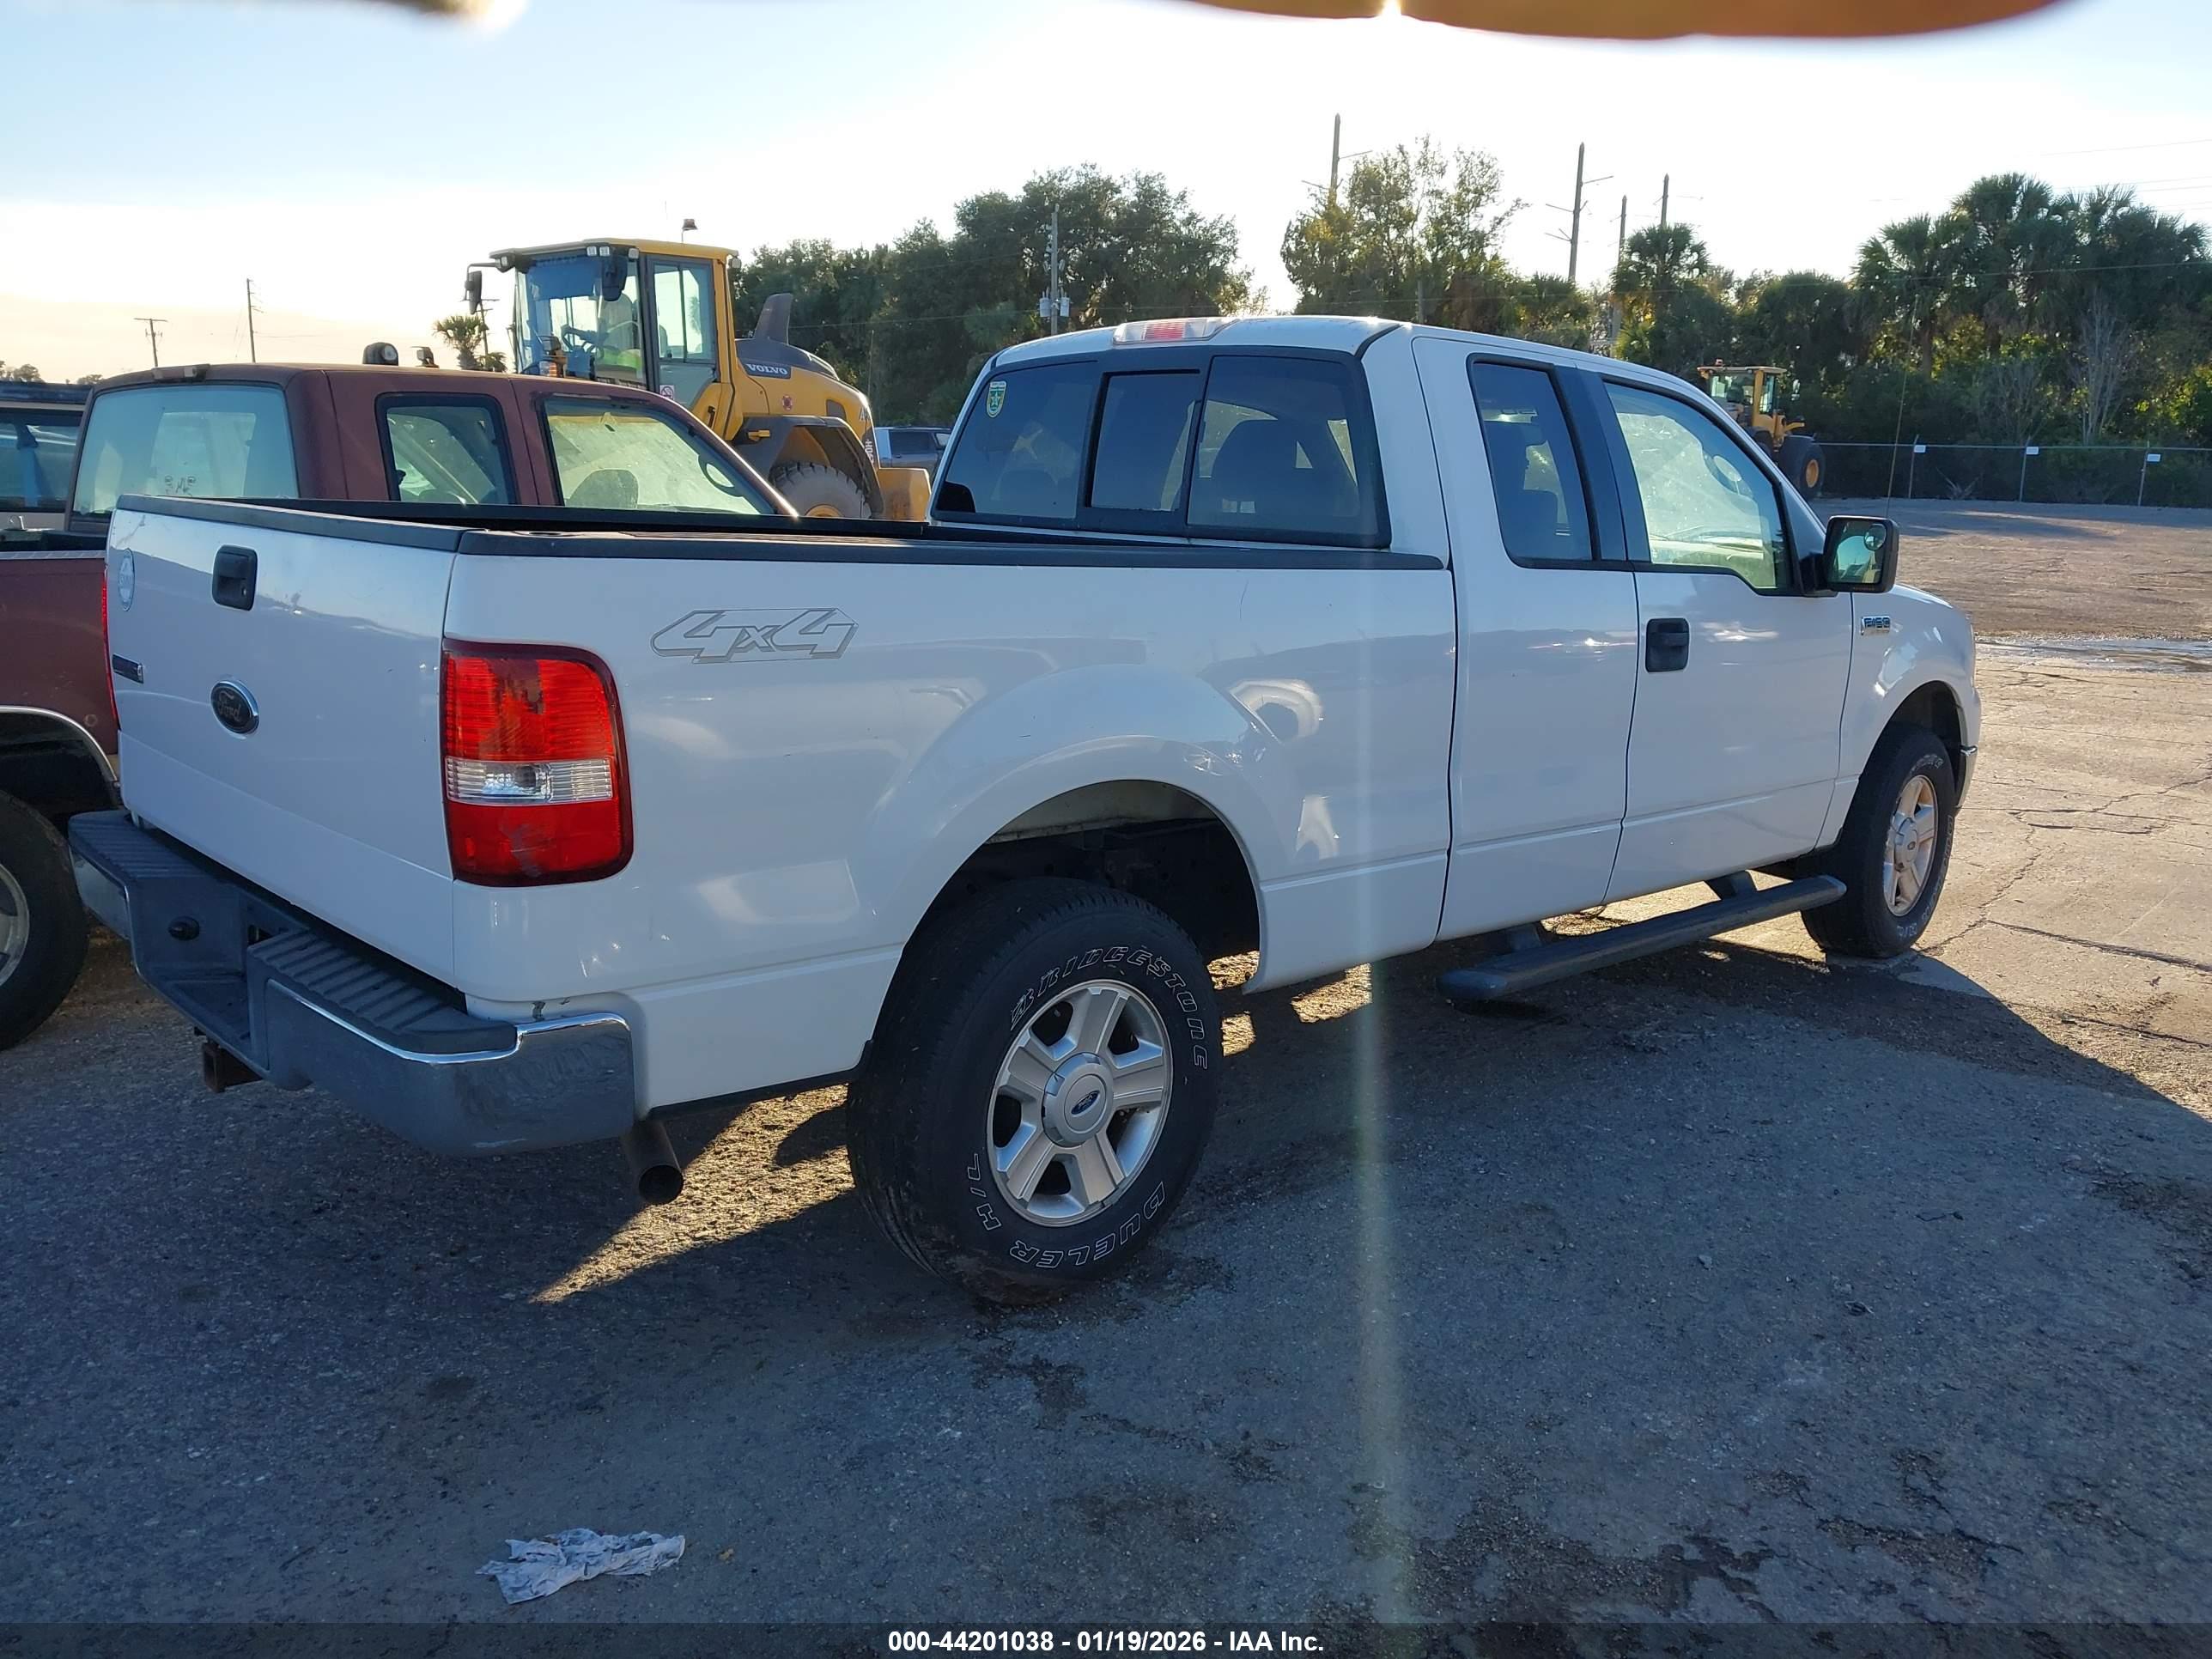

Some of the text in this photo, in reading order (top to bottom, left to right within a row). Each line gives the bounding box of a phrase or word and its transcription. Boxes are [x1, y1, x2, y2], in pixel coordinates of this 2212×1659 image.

[745, 363, 788, 375] VOLVO
[650, 608, 859, 664] 4x4
[216, 690, 242, 723] Ford
[1010, 946, 1208, 1070] BRIDGESTONE
[1009, 1182, 1166, 1268] DUELER
